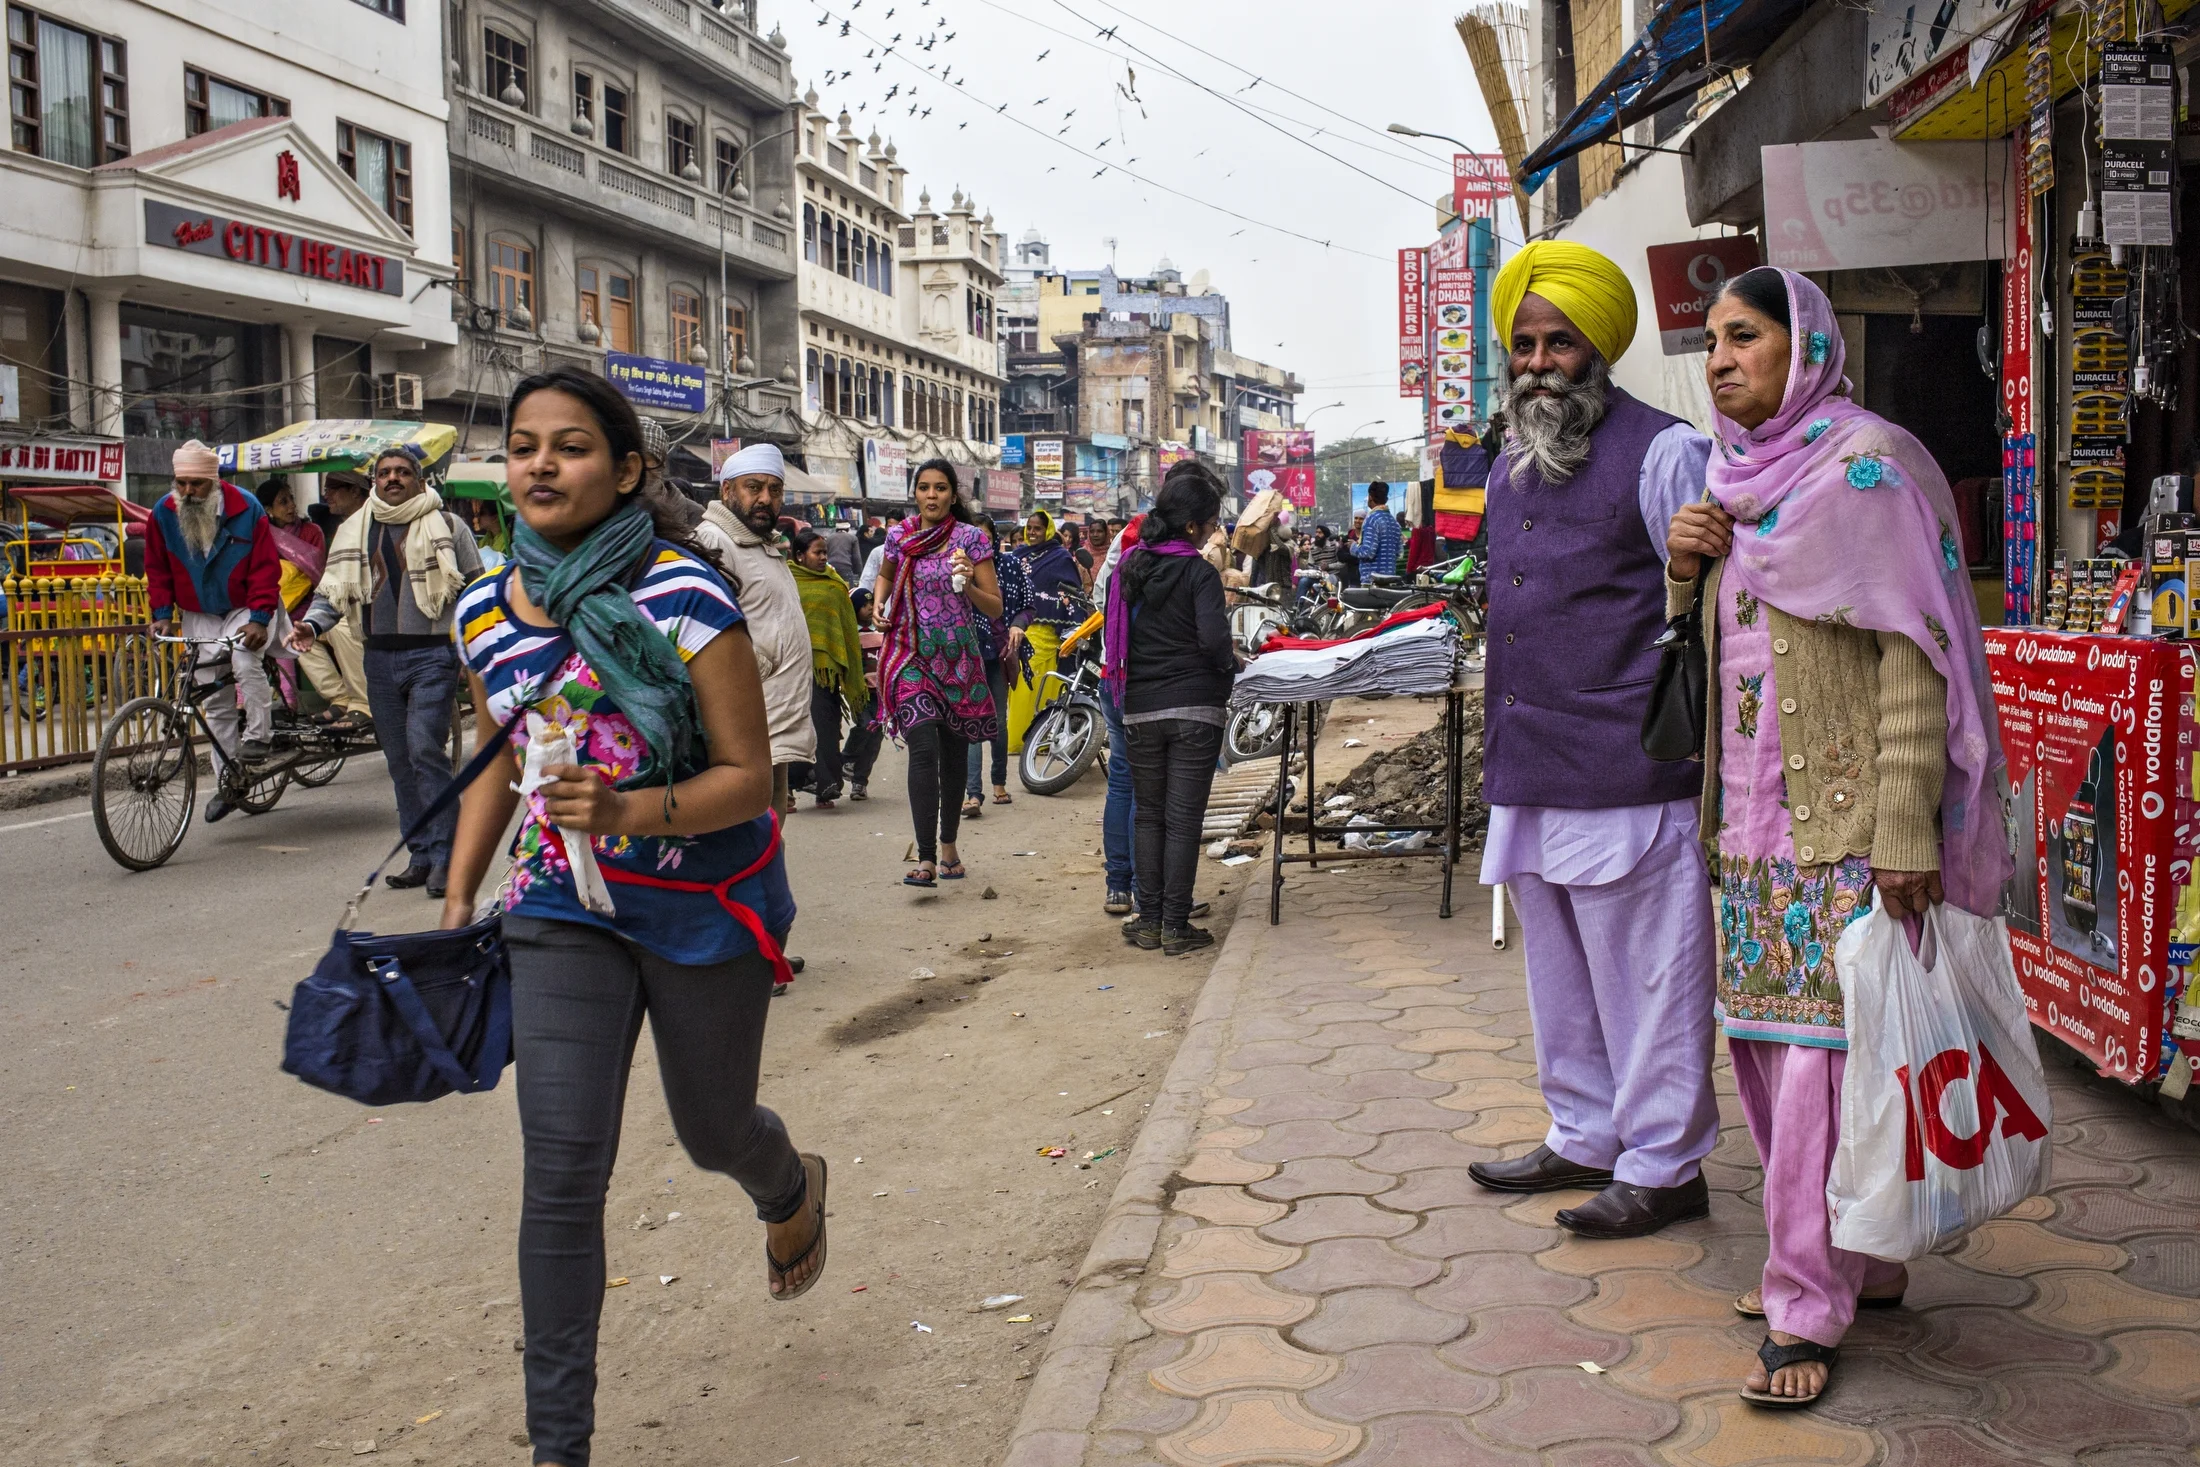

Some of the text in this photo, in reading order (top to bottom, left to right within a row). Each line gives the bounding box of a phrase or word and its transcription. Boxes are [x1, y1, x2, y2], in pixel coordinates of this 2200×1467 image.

[2105, 54, 2147, 62] DURACELL
[1455, 158, 1511, 177] BROTHE
[2105, 161, 2145, 169] DURACELL
[2109, 170, 2117, 178] 10
[2019, 148, 2027, 227] vodafone
[223, 220, 293, 269] CITY
[302, 238, 388, 291] HEART
[1438, 271, 1472, 281] BROTHERS
[1404, 251, 1418, 335] BROTHERS
[1438, 290, 1472, 302] DHABA
[2006, 278, 2014, 355] vodafone
[2020, 274, 2028, 351] vodafone
[1401, 345, 1422, 360] DHABA
[2075, 374, 2116, 382] DURACELL
[105, 447, 119, 459] DRY
[2073, 449, 2115, 457] DURACELL
[2101, 625, 2117, 634] SanDisk
[1985, 638, 2127, 668] dafone vodafone vodaf
[1991, 680, 2105, 715] odafone vodafone vodafone
[2143, 679, 2163, 784] vodafone
[2119, 769, 2127, 853] vodafone
[2142, 854, 2156, 957] vodafone
[2012, 935, 2123, 996] vodafone vodafone vodafo
[2034, 965, 2130, 1026] vodafone vodafone
[2060, 1012, 2096, 1045] vodafone
[1894, 1038, 2049, 1182] ICA
